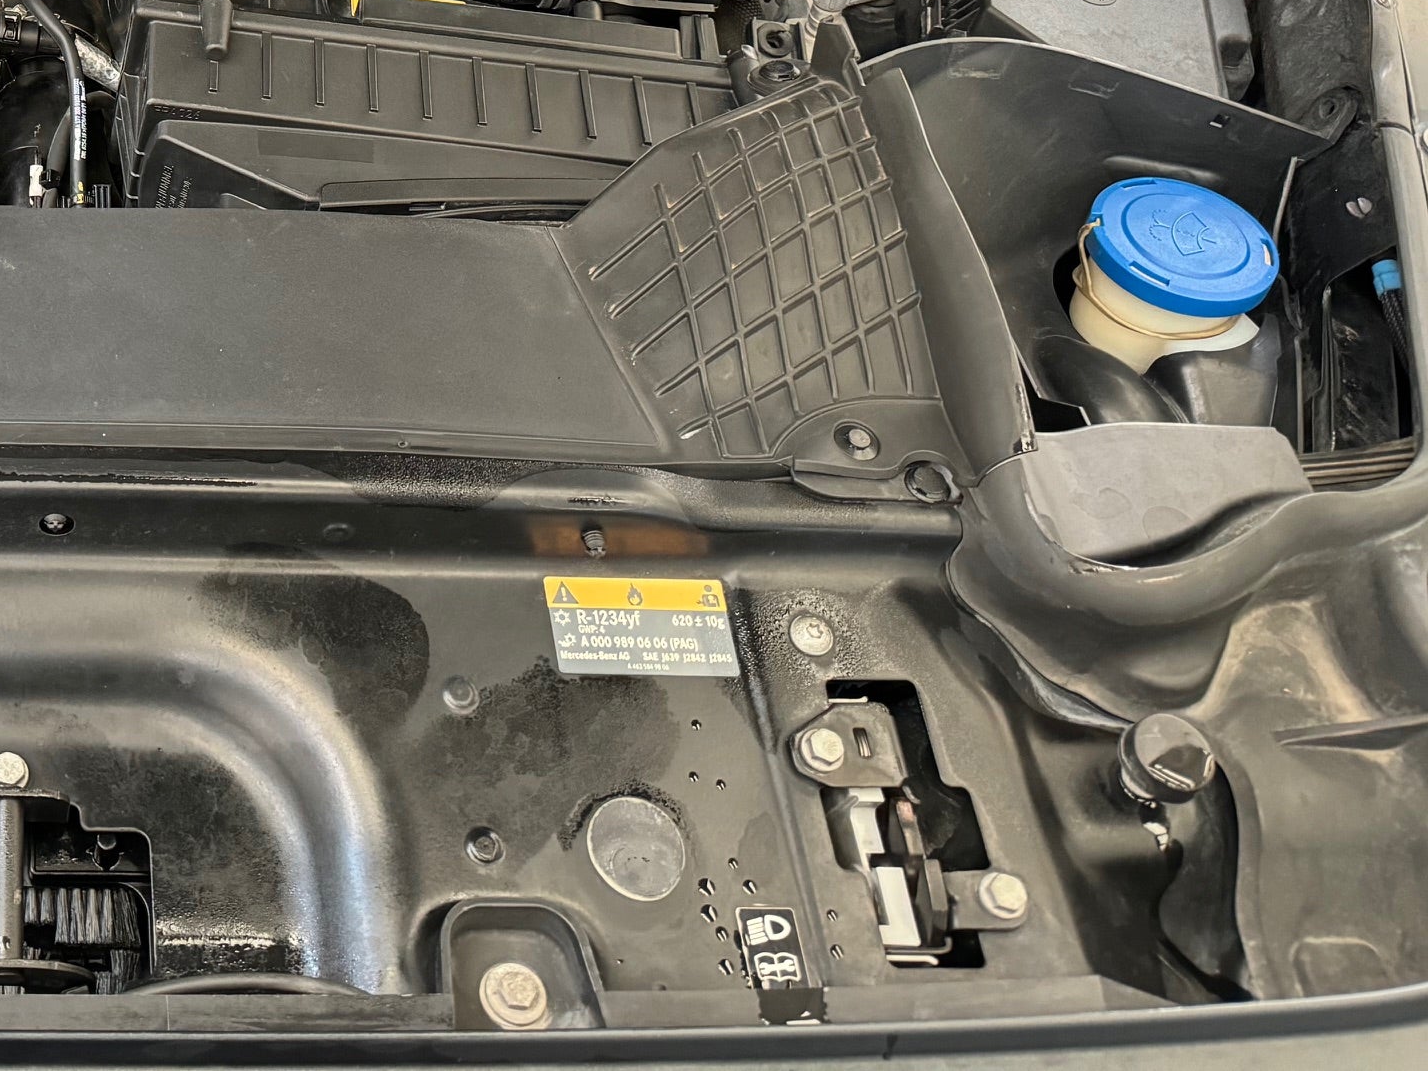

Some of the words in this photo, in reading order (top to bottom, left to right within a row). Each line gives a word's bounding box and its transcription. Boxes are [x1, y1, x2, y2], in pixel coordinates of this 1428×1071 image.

[576, 609, 640, 629] R-1234yf
[672, 614, 693, 626] 620
[705, 615, 726, 629] 10g
[581, 635, 589, 647] A
[590, 635, 611, 648] 000
[613, 636, 634, 648] 989
[636, 636, 652, 649] 06
[653, 637, 668, 649] 06
[669, 637, 698, 652] (PAG)
[560, 650, 617, 660] Mercedes-Benz
[618, 651, 631, 661] AG
[642, 651, 659, 661] SAE
